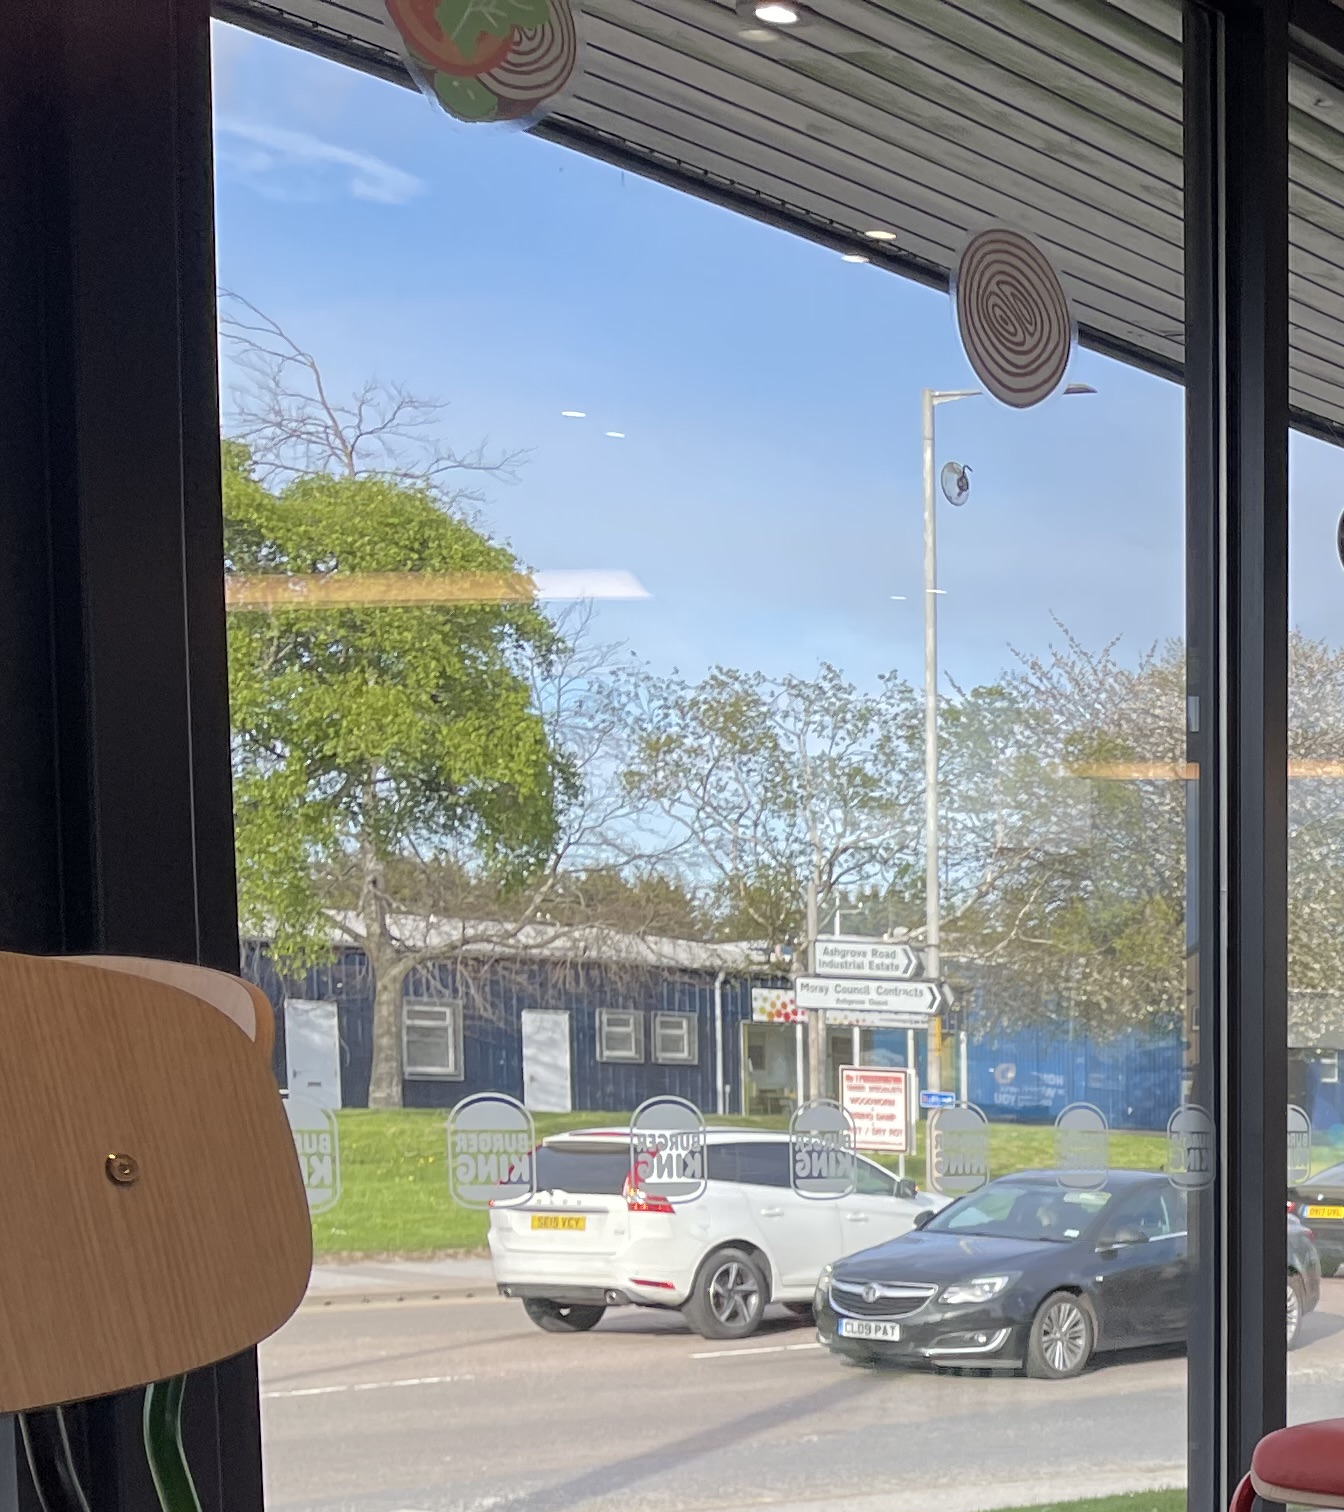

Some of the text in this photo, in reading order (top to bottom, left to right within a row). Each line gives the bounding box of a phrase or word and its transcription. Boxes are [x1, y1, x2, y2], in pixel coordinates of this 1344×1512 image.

[822, 946, 896, 960] Ashgrove Road
[818, 958, 900, 972] Industrial Estate
[800, 983, 924, 998] Moray Council Contracts
